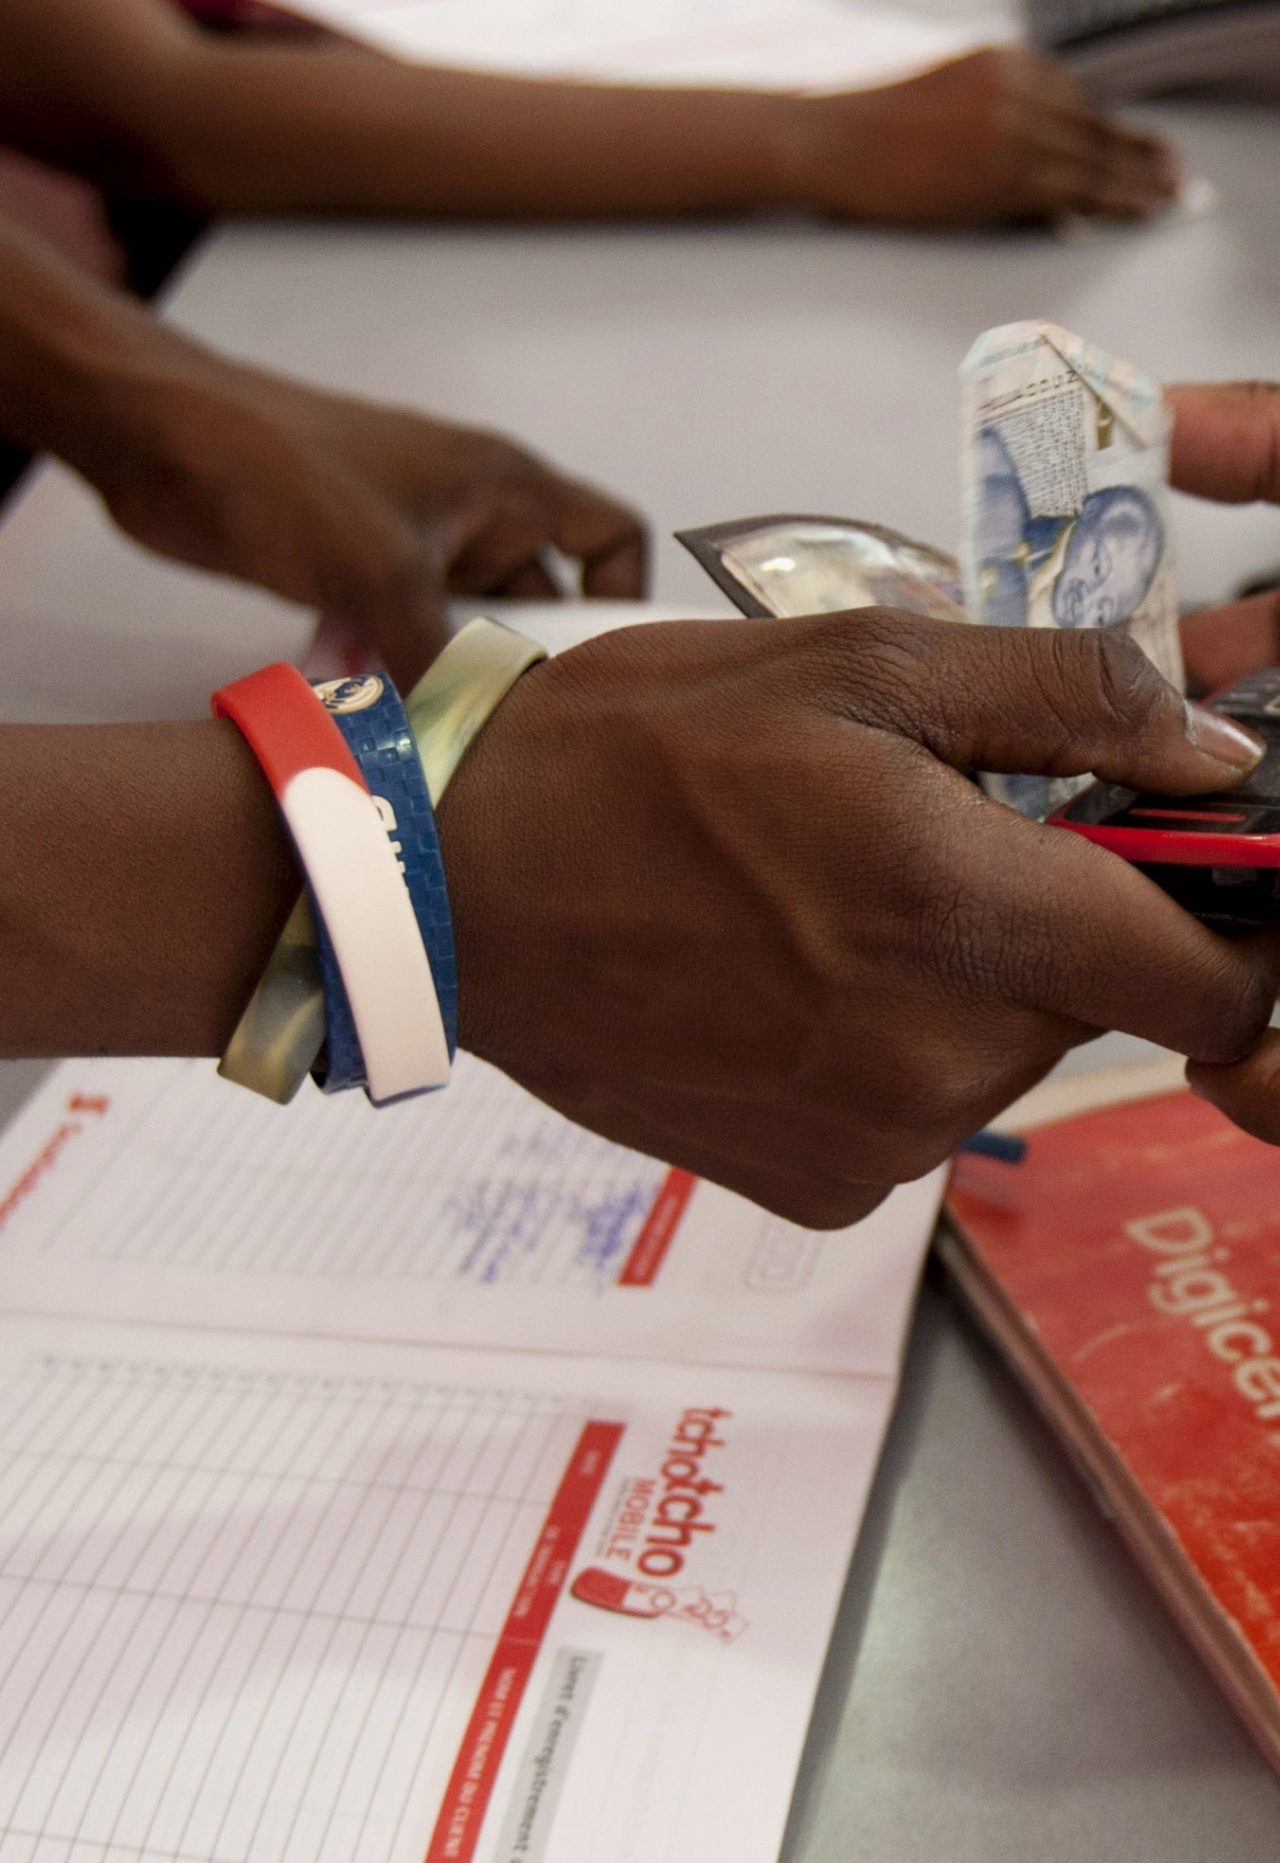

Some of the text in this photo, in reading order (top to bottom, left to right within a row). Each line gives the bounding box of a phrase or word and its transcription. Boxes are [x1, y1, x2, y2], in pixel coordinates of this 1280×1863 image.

[606, 1478, 657, 1561] MOBILE
[636, 1406, 734, 1578] tchotcho
[558, 1655, 588, 1701] Livret
